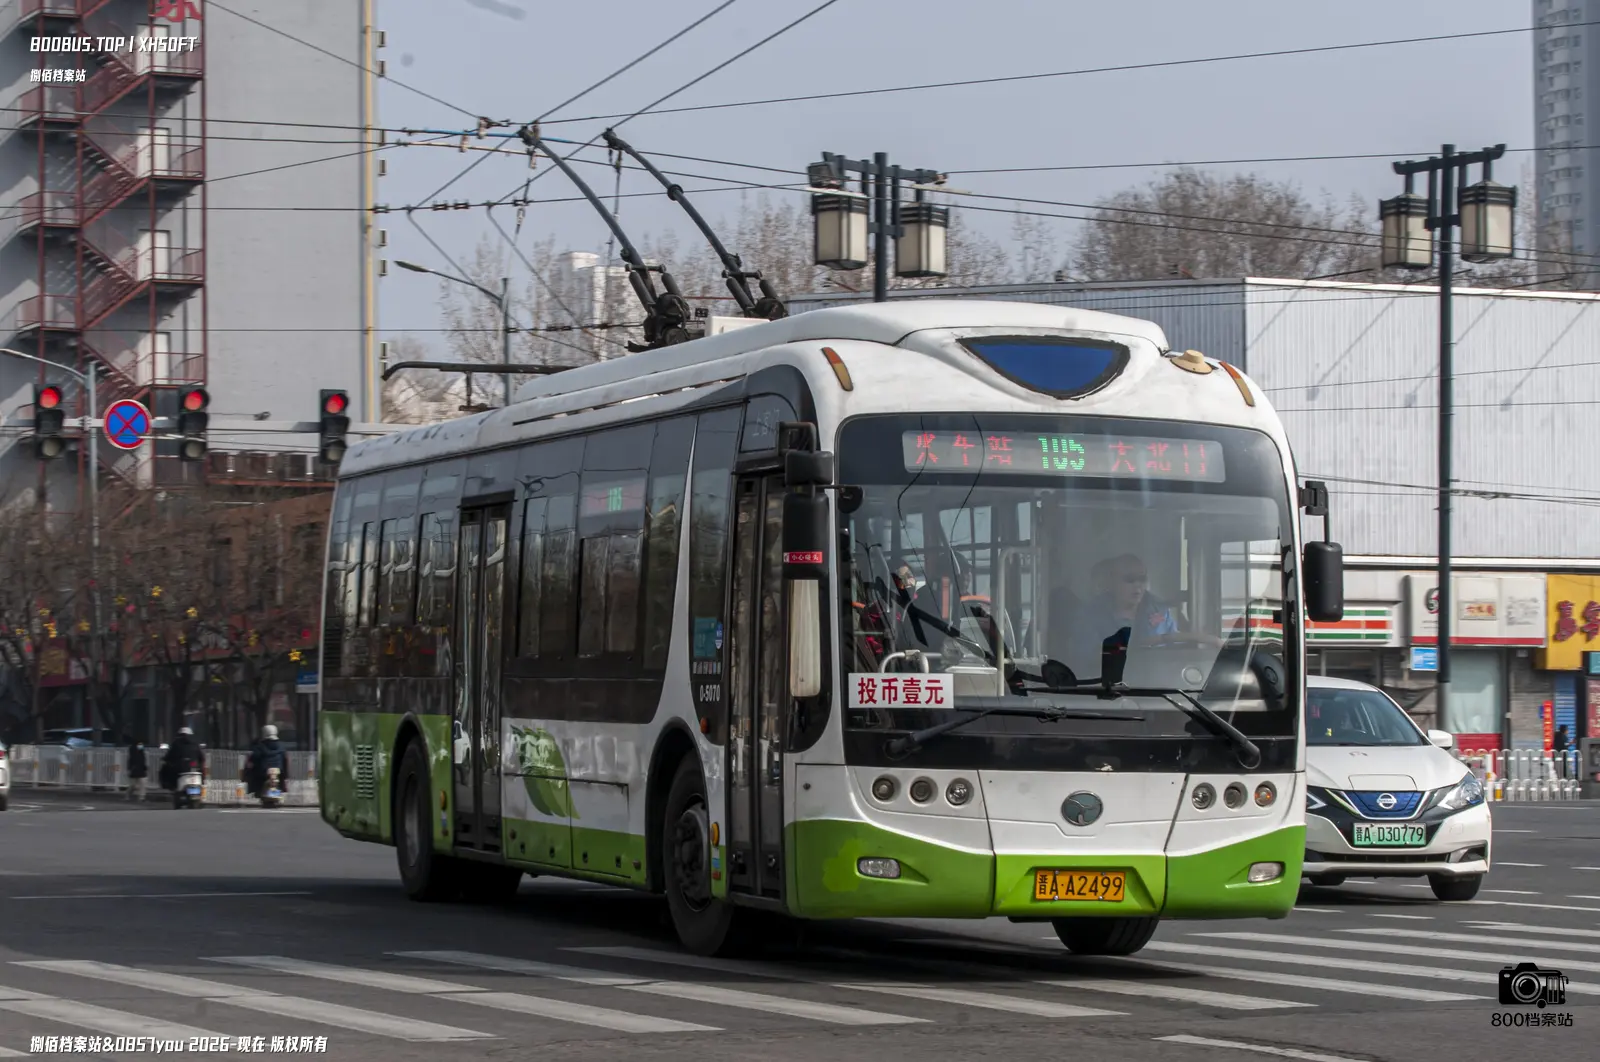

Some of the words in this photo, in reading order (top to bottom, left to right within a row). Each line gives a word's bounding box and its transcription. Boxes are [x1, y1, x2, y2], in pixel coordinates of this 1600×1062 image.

[1038, 436, 1085, 470] 105
[857, 677, 944, 705] 投币壹元
